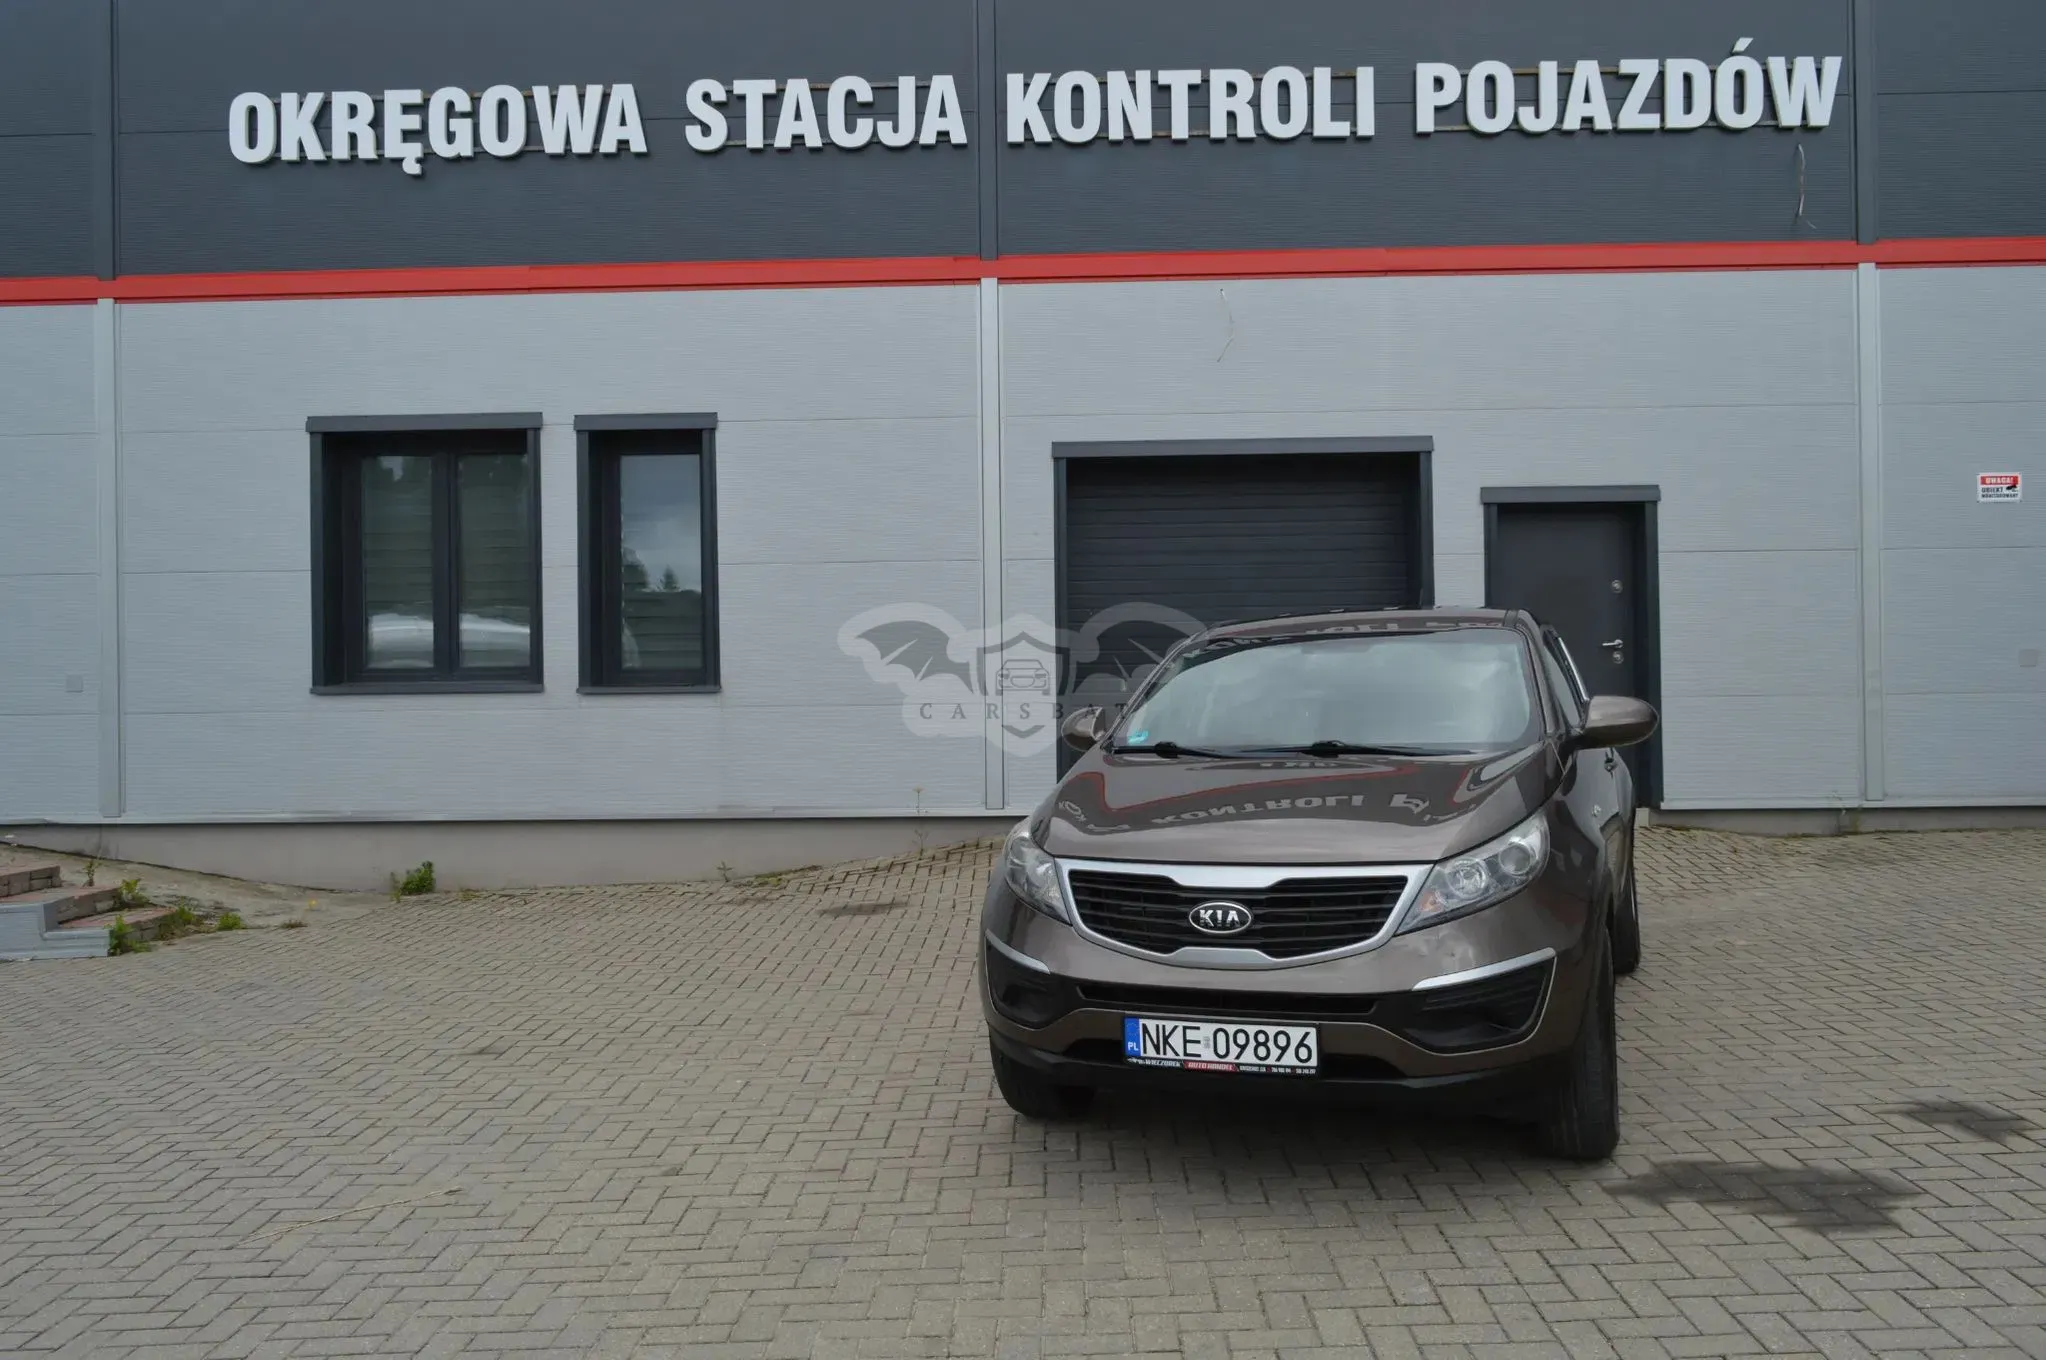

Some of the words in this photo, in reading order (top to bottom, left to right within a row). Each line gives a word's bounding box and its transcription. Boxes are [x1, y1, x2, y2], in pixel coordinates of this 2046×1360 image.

[228, 83, 647, 176] OKRĘGOWA
[684, 74, 969, 152] STACJA
[1005, 65, 1376, 144] KONTROLI
[1415, 37, 1843, 133] POJAZDÓW
[1199, 909, 1240, 927] KIA
[1128, 1041, 1139, 1051] PL
[1141, 1023, 1202, 1058] NKE
[1212, 1027, 1313, 1064] 09896
